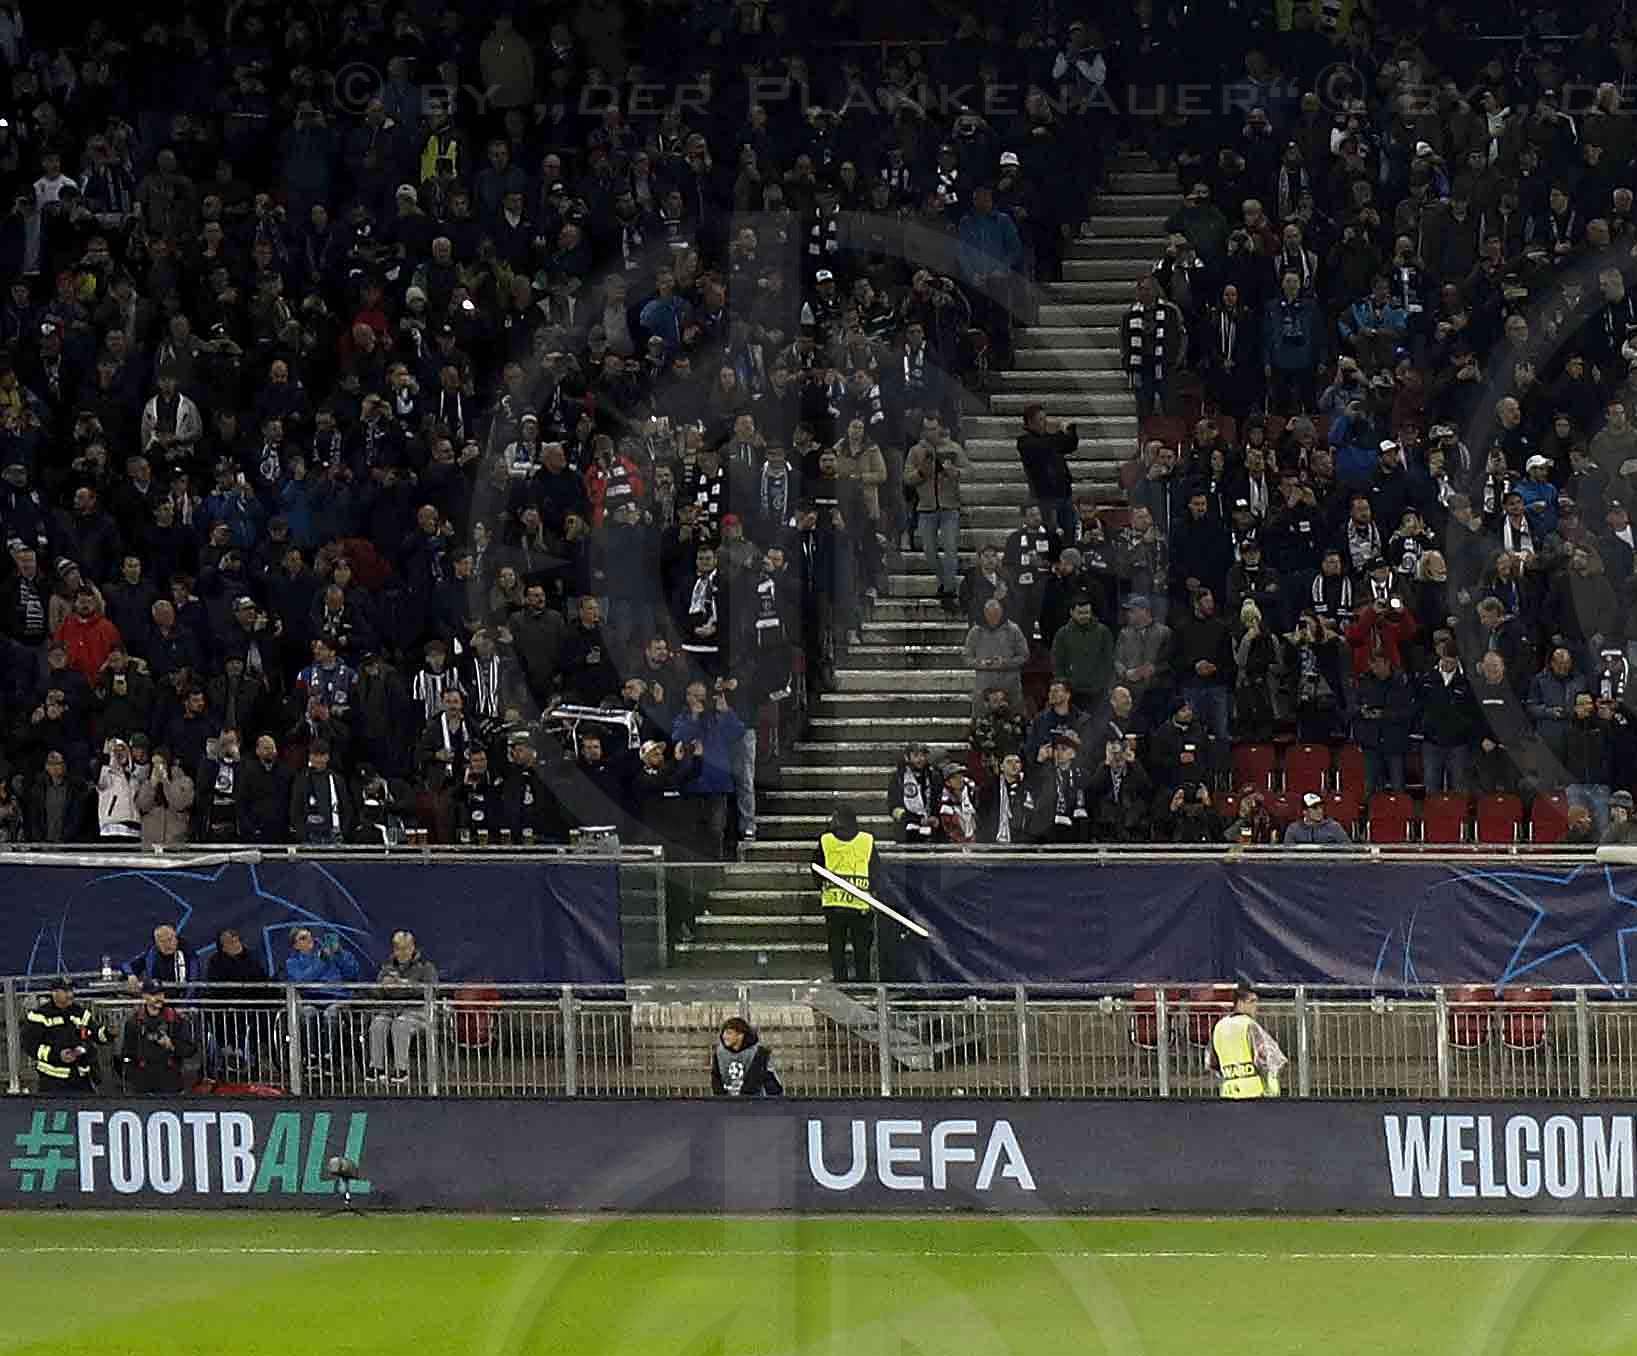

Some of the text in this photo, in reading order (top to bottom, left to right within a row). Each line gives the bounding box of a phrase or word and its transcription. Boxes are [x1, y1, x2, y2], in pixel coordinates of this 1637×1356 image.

[1221, 1062, 1256, 1078] WARD
[11, 1111, 371, 1194] #FOOTBALL
[807, 1118, 1038, 1191] UEFA
